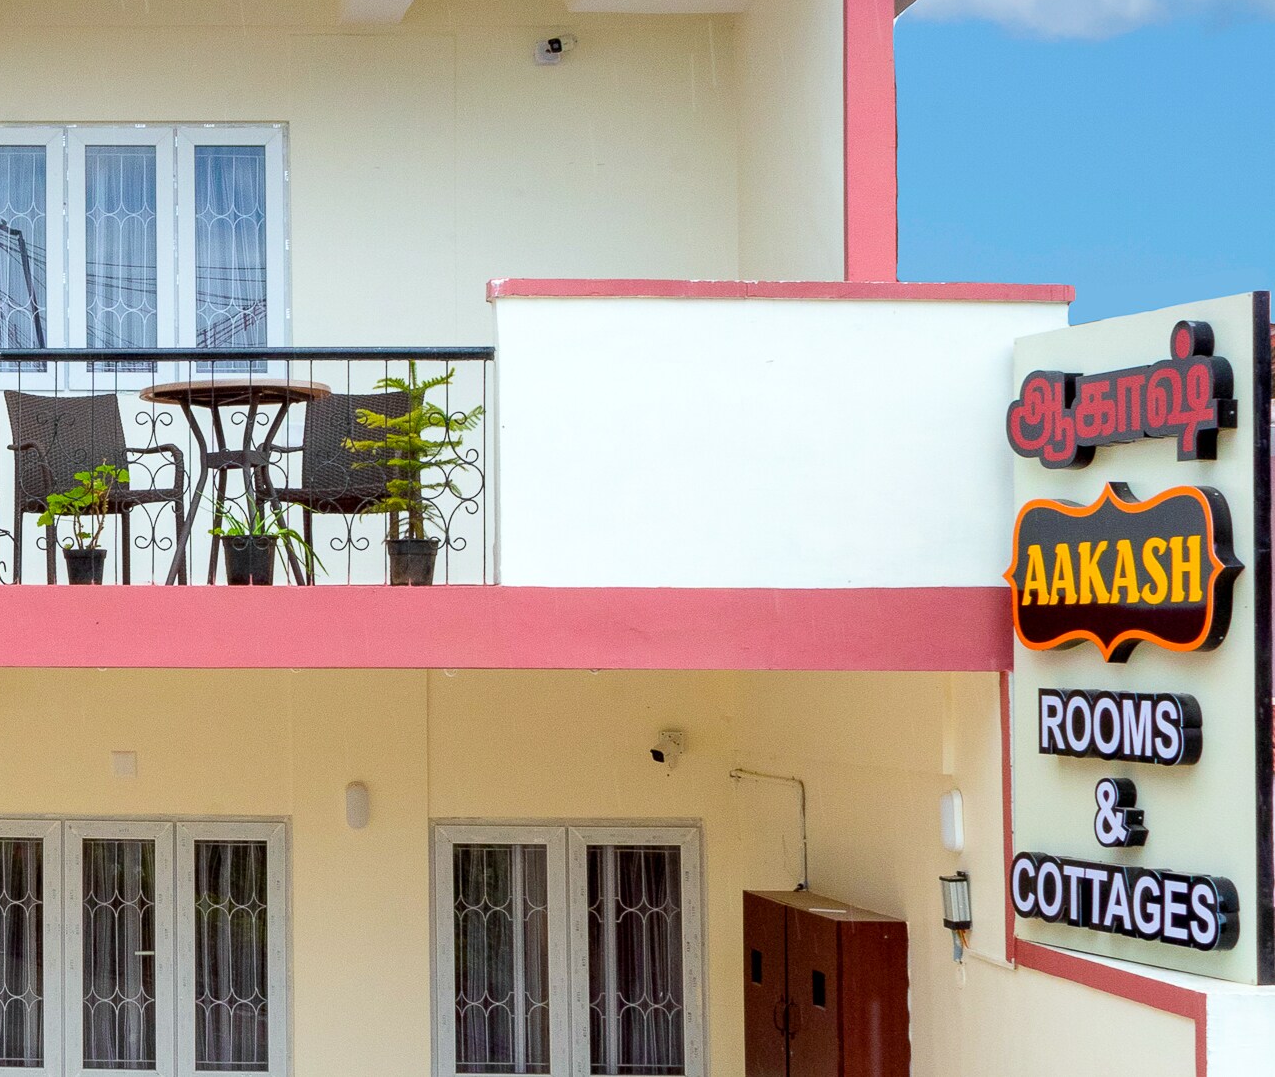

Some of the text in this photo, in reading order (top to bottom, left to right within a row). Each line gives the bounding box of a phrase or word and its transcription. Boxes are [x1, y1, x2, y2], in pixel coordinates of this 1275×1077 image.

[1011, 328, 1214, 462] ஆகாஷ்
[1022, 535, 1203, 606] AAKASH
[1041, 695, 1179, 759] ROOMS
[1095, 781, 1127, 844] &
[1012, 858, 1216, 944] COTTAGES
